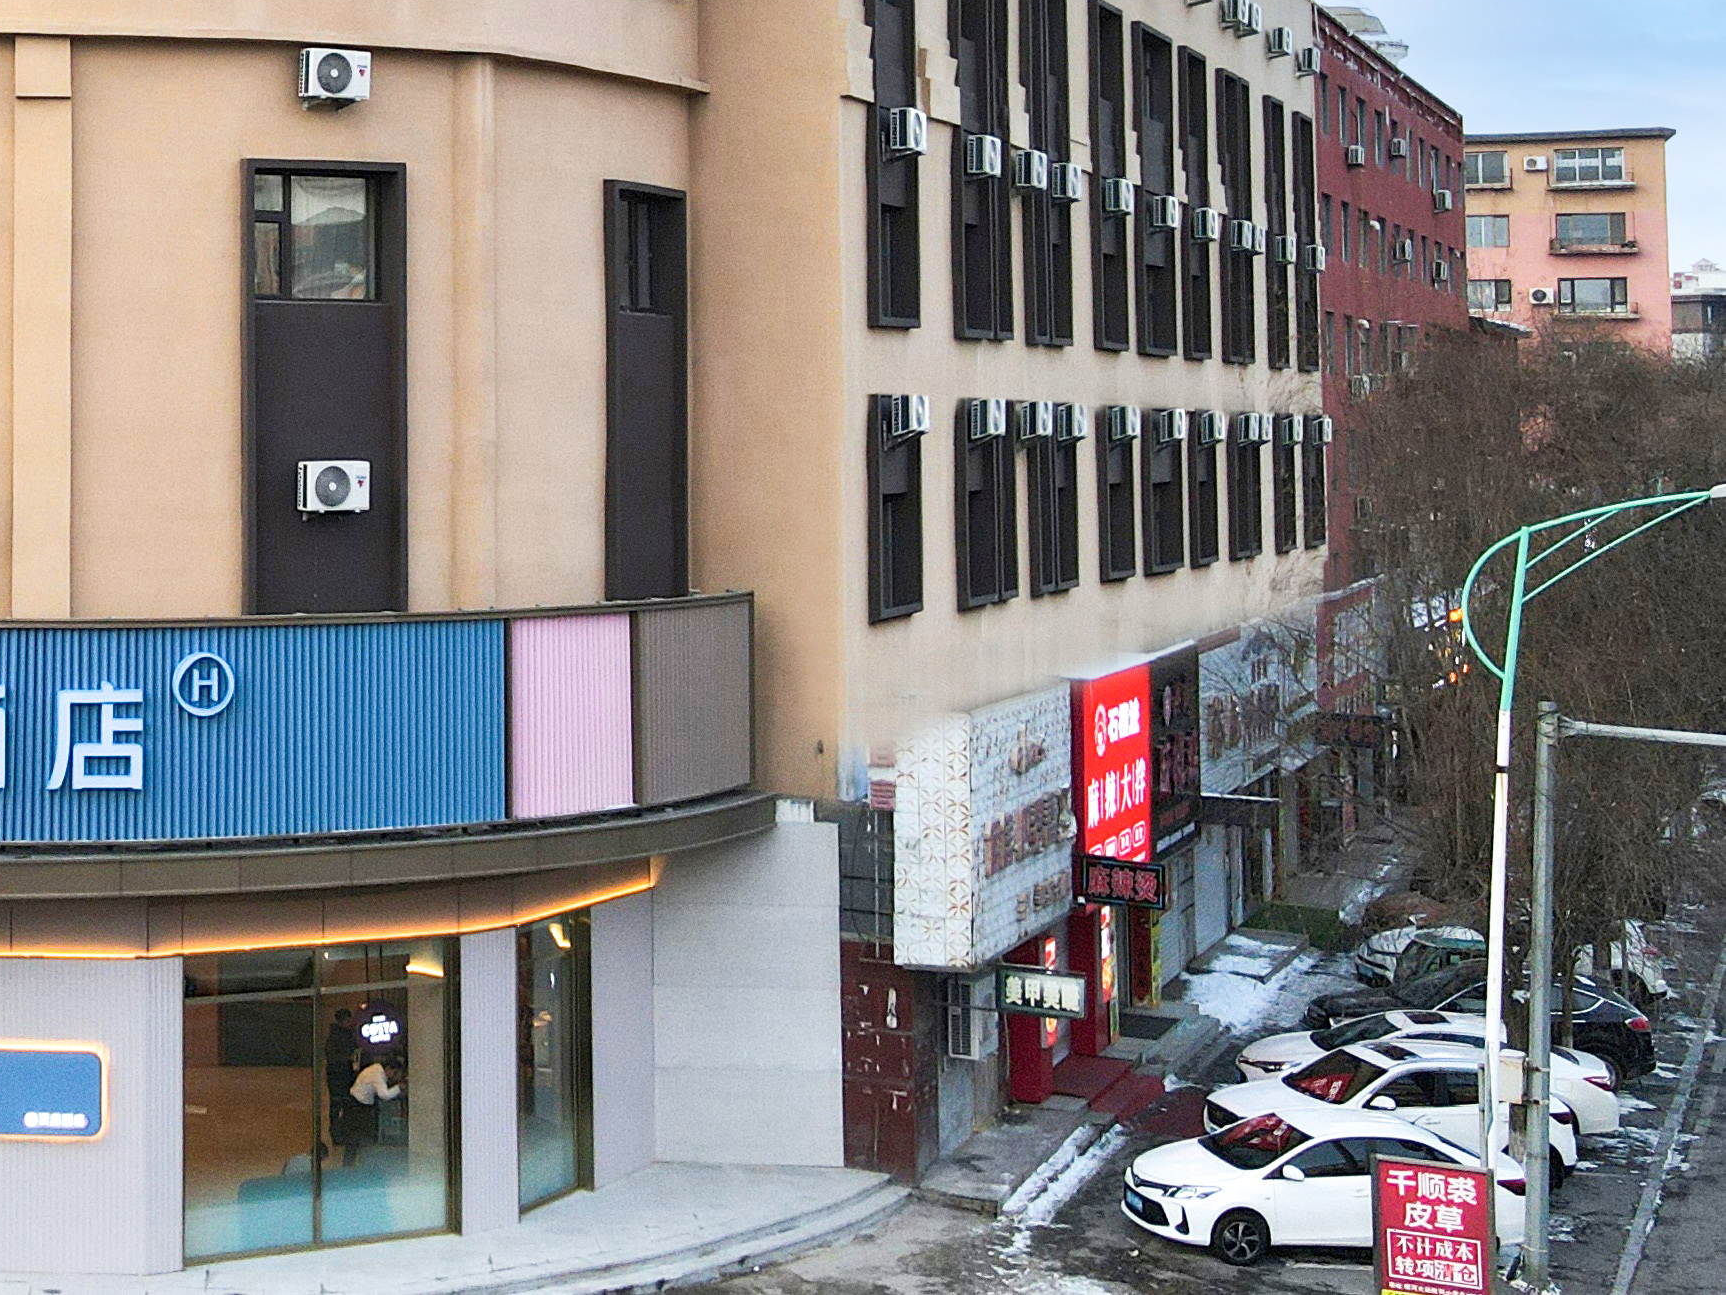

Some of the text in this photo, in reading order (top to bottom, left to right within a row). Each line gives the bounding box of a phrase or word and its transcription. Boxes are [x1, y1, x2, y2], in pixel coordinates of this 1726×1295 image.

[1088, 866, 1159, 903] 麻辣烫
[1404, 1201, 1465, 1233] 皮草
[1396, 1235, 1475, 1262] 不计成本
